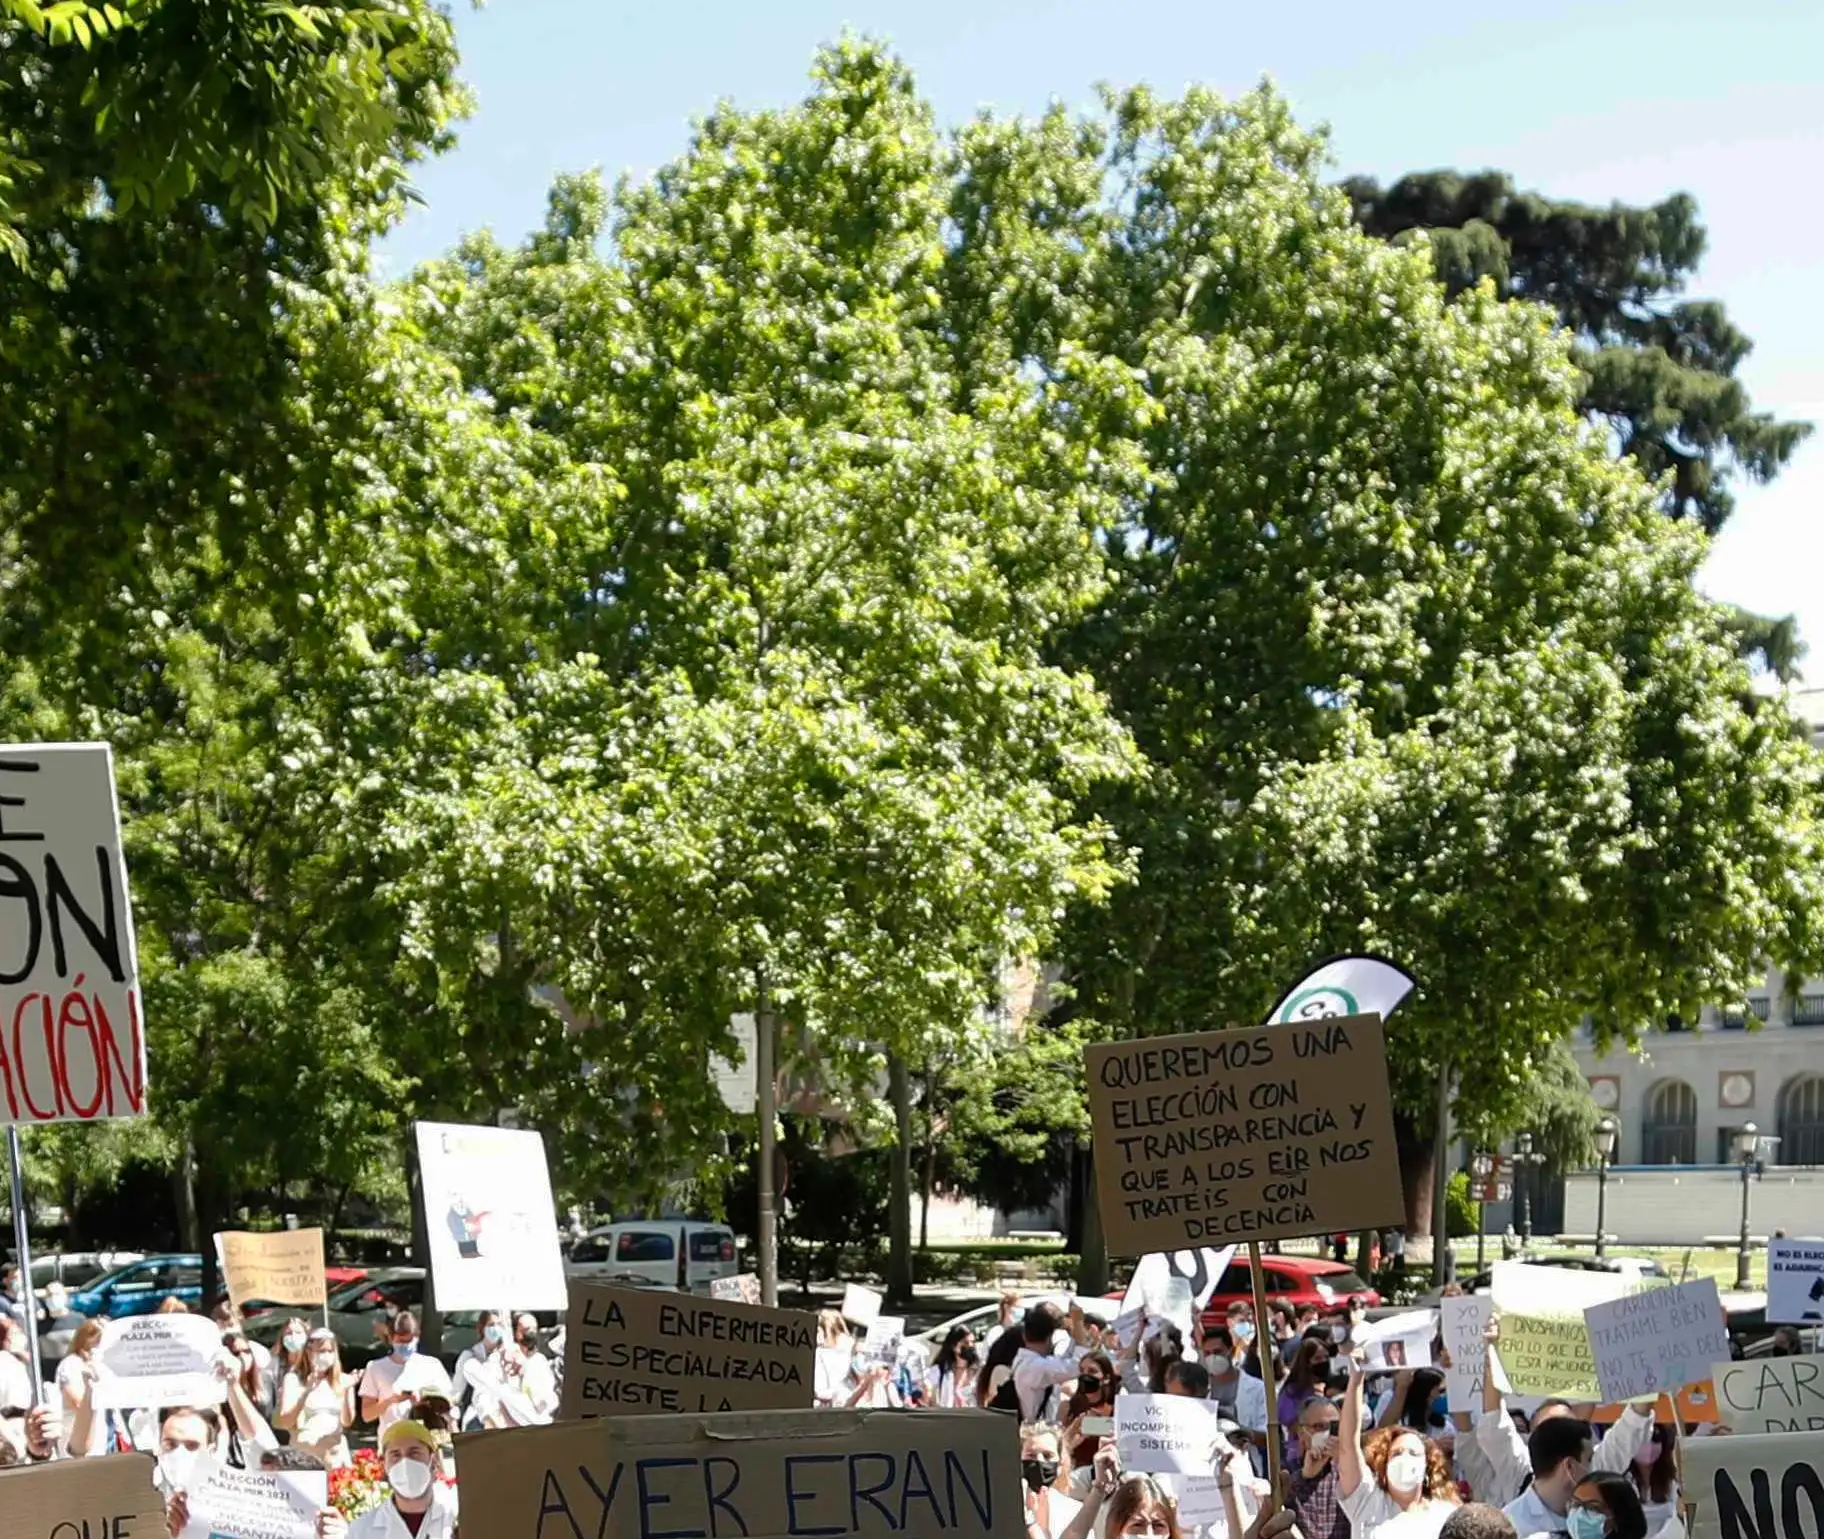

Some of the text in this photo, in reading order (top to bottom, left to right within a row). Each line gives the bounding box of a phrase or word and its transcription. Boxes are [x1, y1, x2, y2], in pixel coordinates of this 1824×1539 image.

[1100, 1025, 1353, 1088] QUEREMOS UNA
[1112, 1079, 1299, 1129] ELECCIÓN CON
[1115, 1104, 1367, 1163] TRANSPARENCIA Y
[1121, 1139, 1374, 1192] QUE A LOS EIR NOS
[1262, 1178, 1307, 1203] CON
[1184, 1203, 1316, 1240] DECENCIA
[580, 1298, 812, 1351] LA ENFERMERÍA
[580, 1343, 803, 1386] ESPECIALIZADA
[783, 1447, 994, 1536] ERAN
